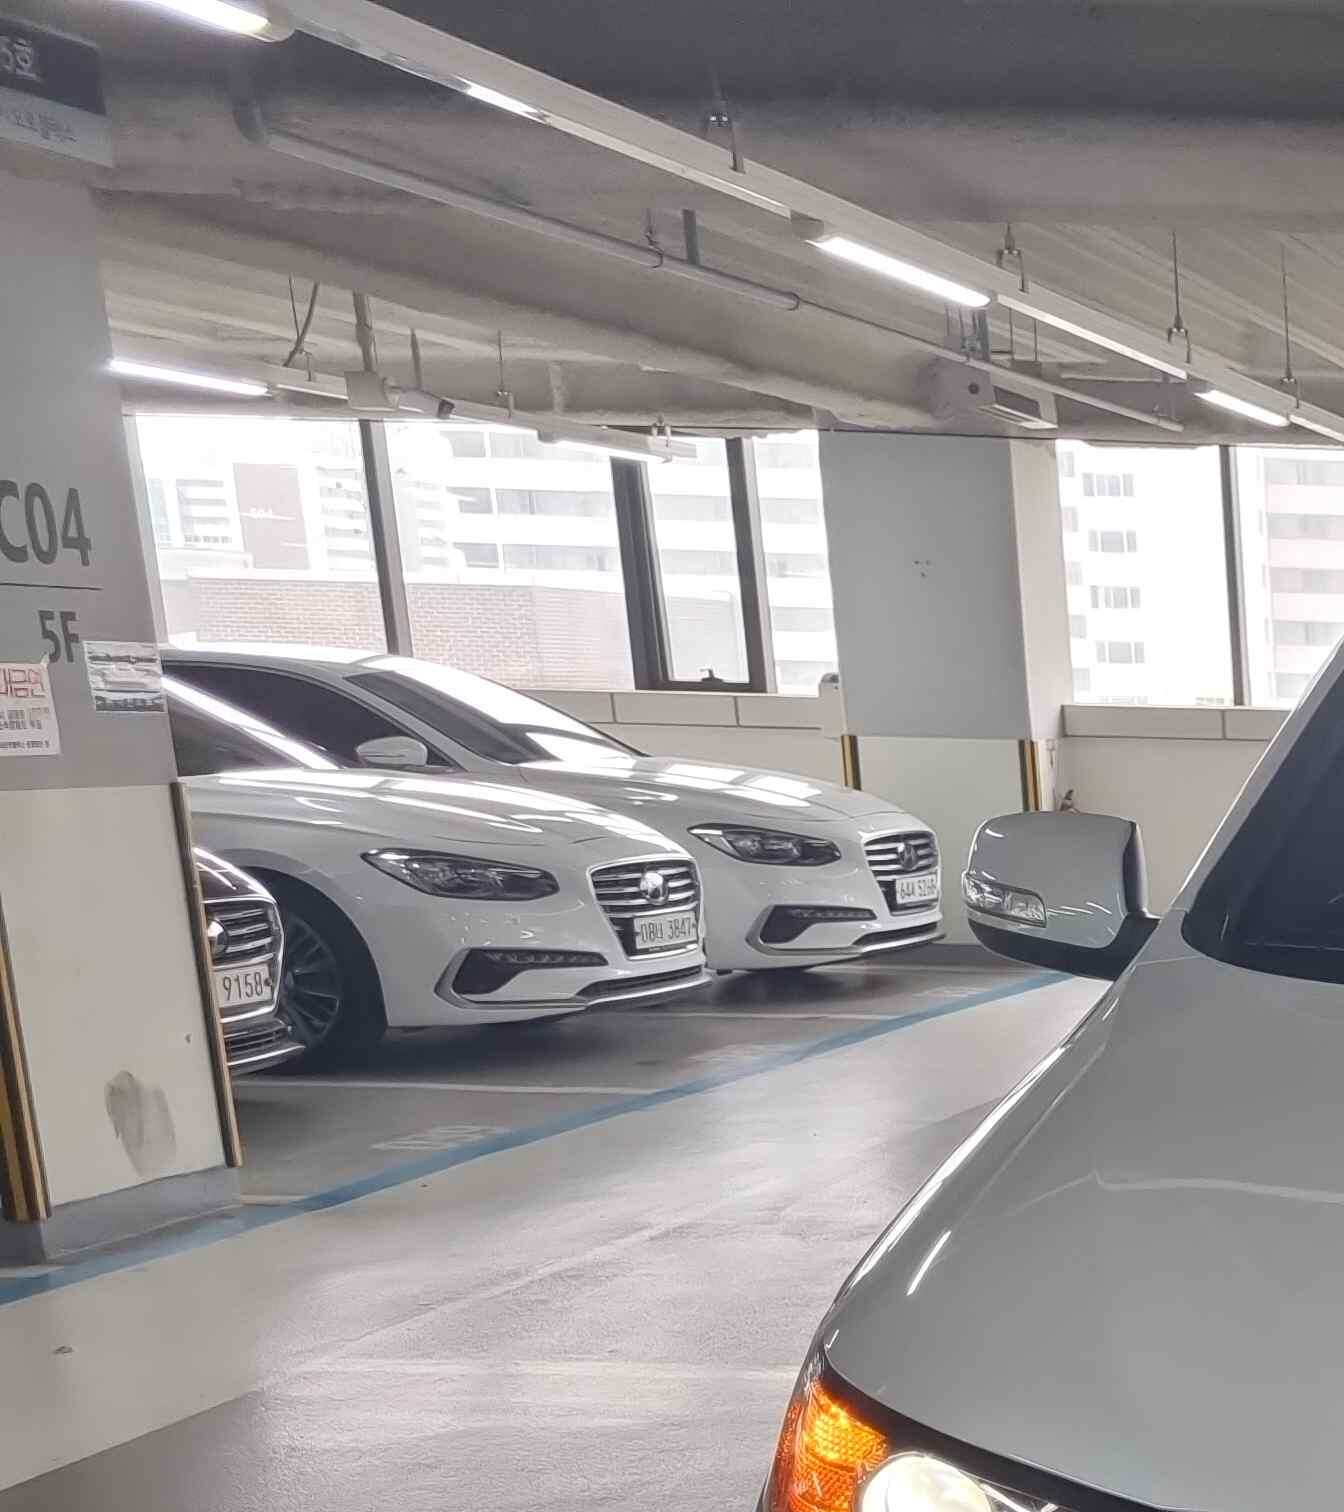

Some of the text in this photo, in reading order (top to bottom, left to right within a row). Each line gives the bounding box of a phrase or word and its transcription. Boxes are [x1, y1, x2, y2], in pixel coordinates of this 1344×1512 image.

[0, 480, 92, 567] C04
[38, 610, 79, 664] 5F
[222, 971, 263, 1001] 9158
